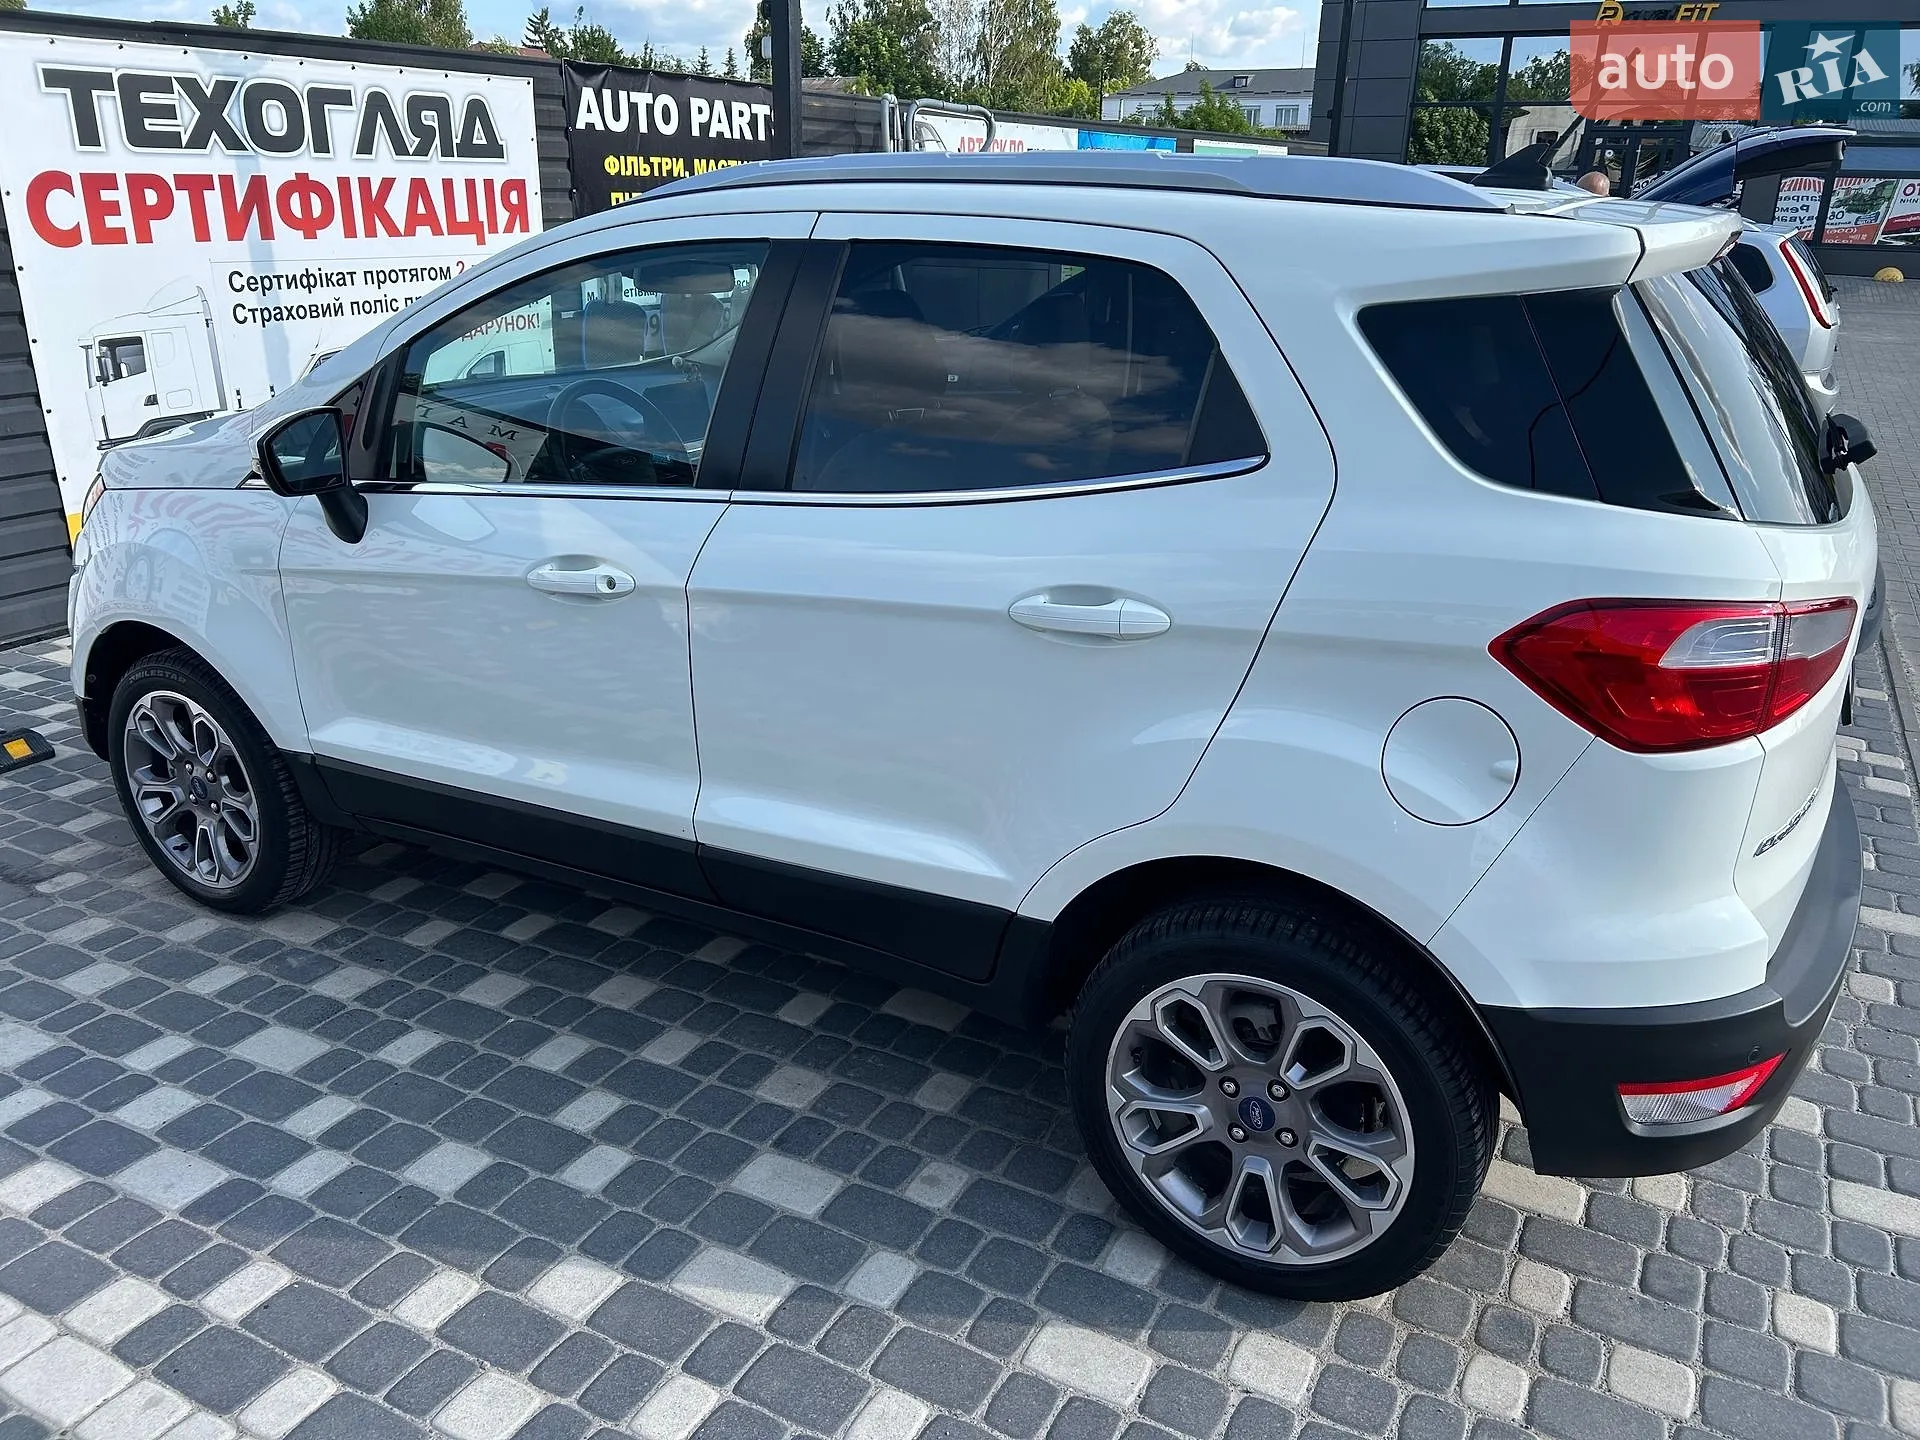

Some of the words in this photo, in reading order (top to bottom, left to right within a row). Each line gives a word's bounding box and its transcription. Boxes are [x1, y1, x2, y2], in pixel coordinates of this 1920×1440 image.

[39, 66, 507, 160] ТЕХОГЛЯД
[576, 87, 679, 136] AUTO
[690, 97, 774, 141] PART
[604, 155, 690, 178] ФІЛЬТРИ,
[26, 170, 530, 248] СЕРТИФІКАЦІЯ
[228, 267, 356, 296] Сертифікат
[364, 266, 451, 289] протягом
[232, 299, 345, 328] Страховий
[351, 294, 399, 316] поліс
